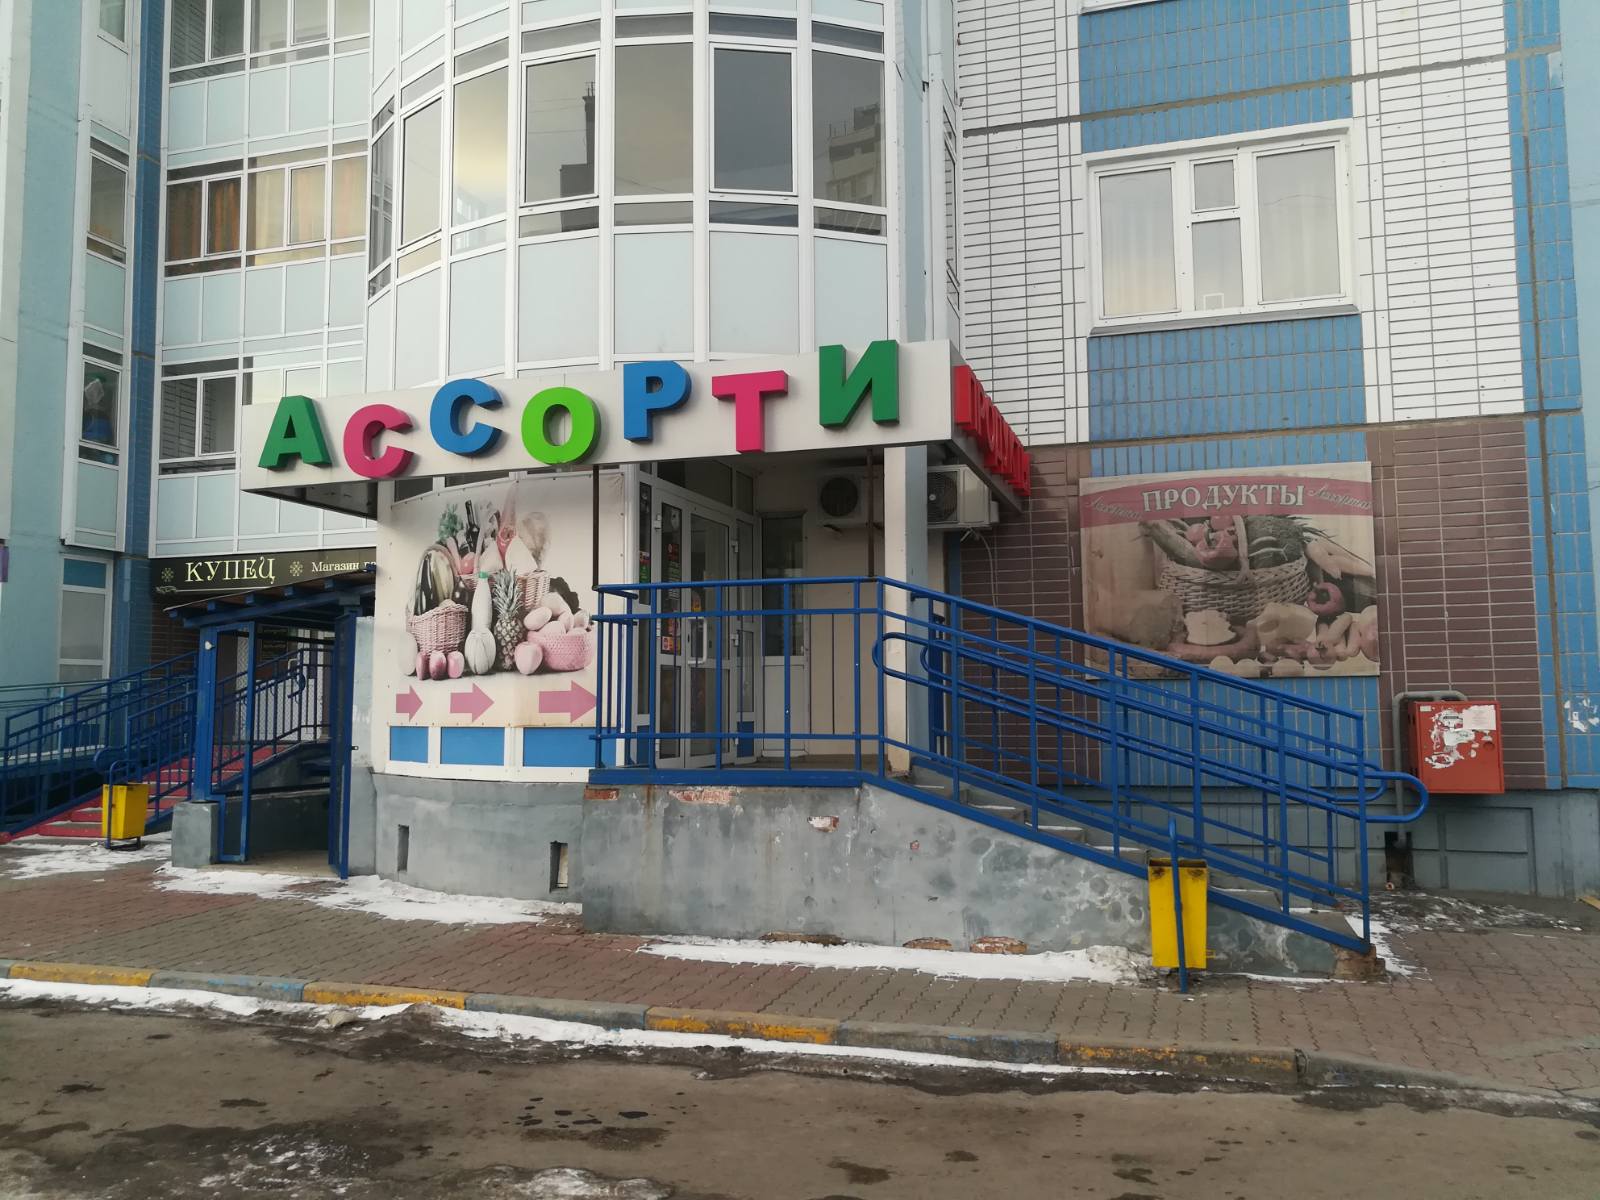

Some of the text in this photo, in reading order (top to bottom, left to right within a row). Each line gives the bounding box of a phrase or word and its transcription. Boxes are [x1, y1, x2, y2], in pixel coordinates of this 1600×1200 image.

[258, 340, 899, 478] АССОРТИ
[1142, 484, 1305, 512] ПРОДУКТЫ
[185, 556, 275, 584] КУПЕЦ
[311, 561, 360, 572] Магазин
